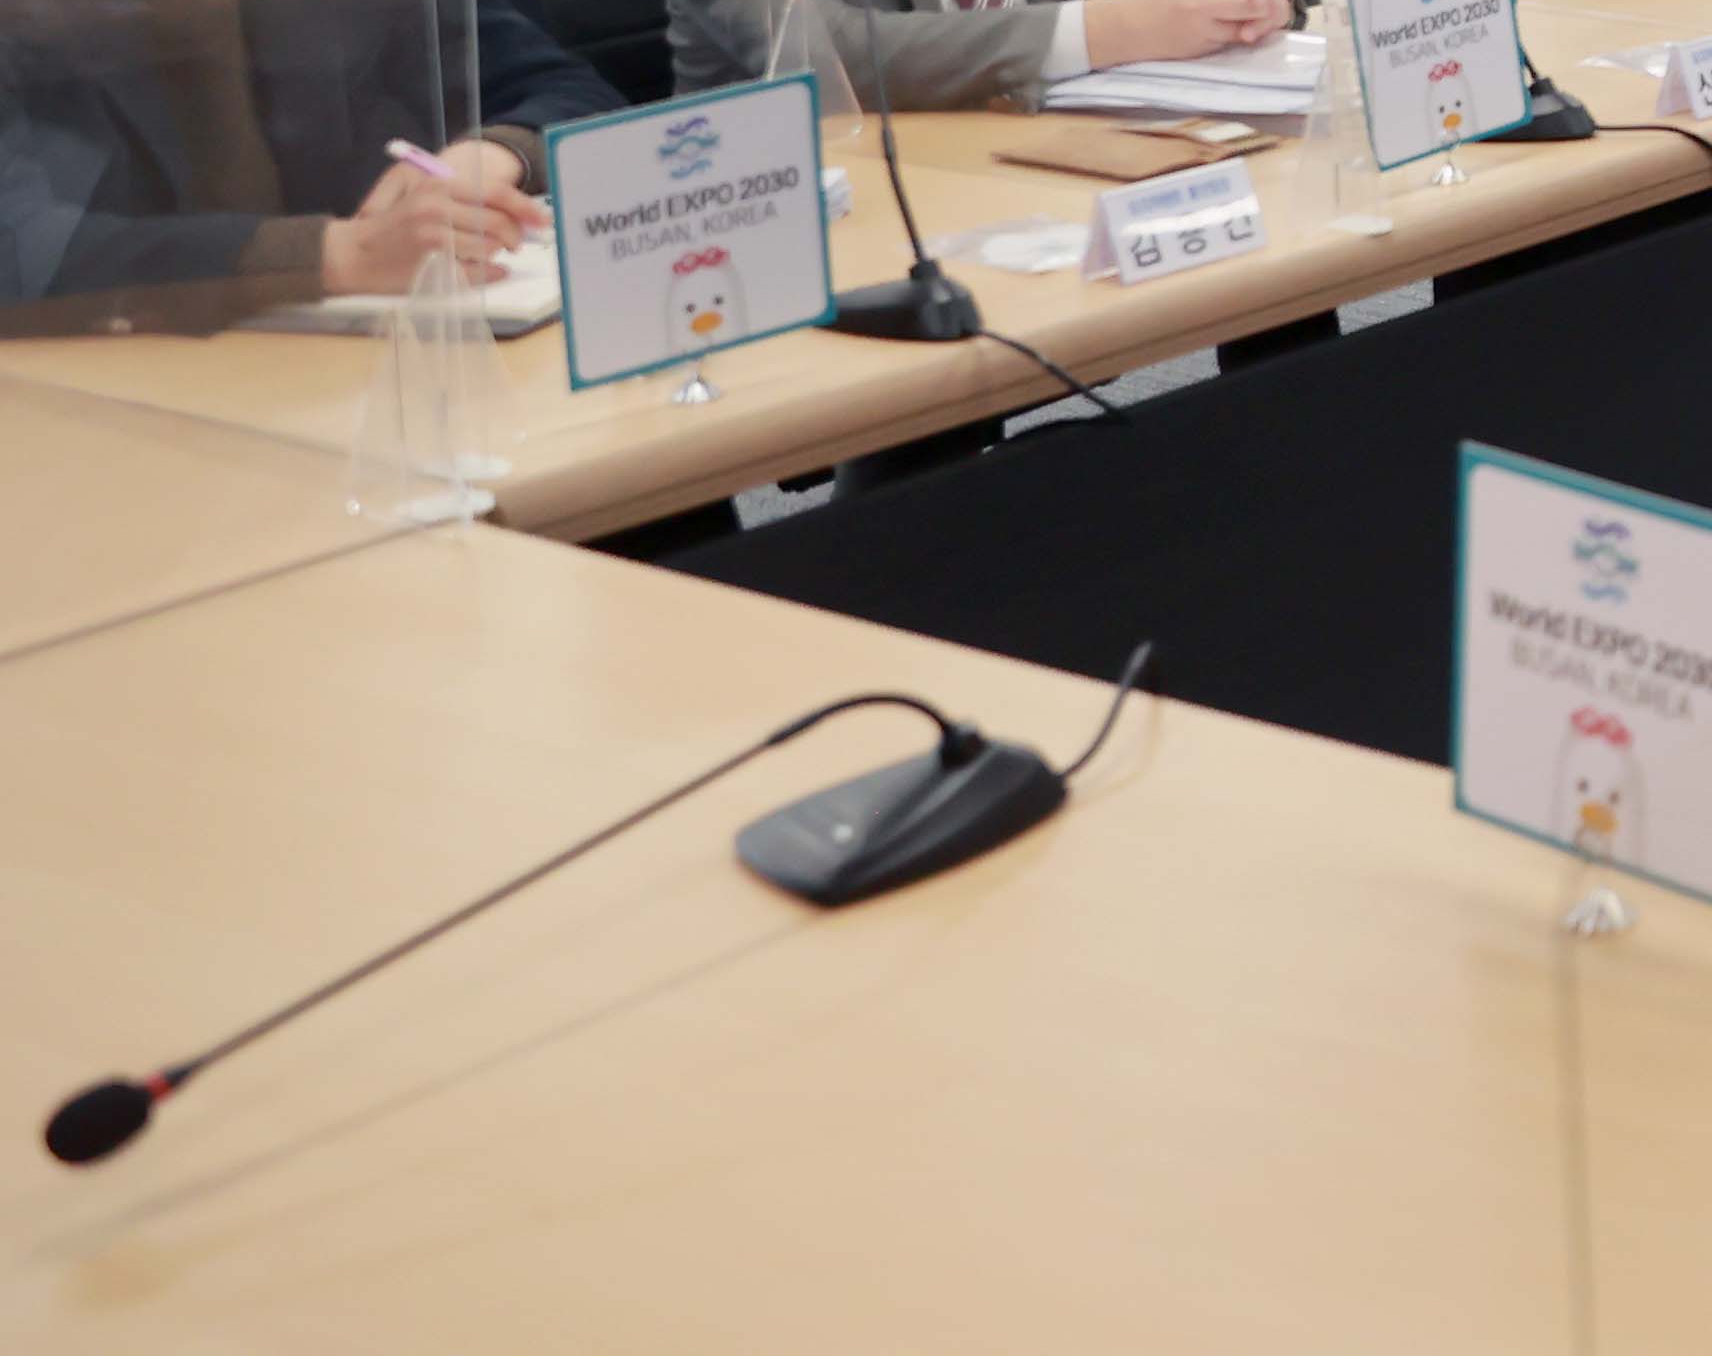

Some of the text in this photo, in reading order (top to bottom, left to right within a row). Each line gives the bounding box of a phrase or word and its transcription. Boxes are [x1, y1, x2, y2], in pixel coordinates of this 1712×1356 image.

[1370, 23, 1417, 49] World
[1420, 7, 1461, 35] EXPO
[584, 165, 801, 240] World EXPO 2030
